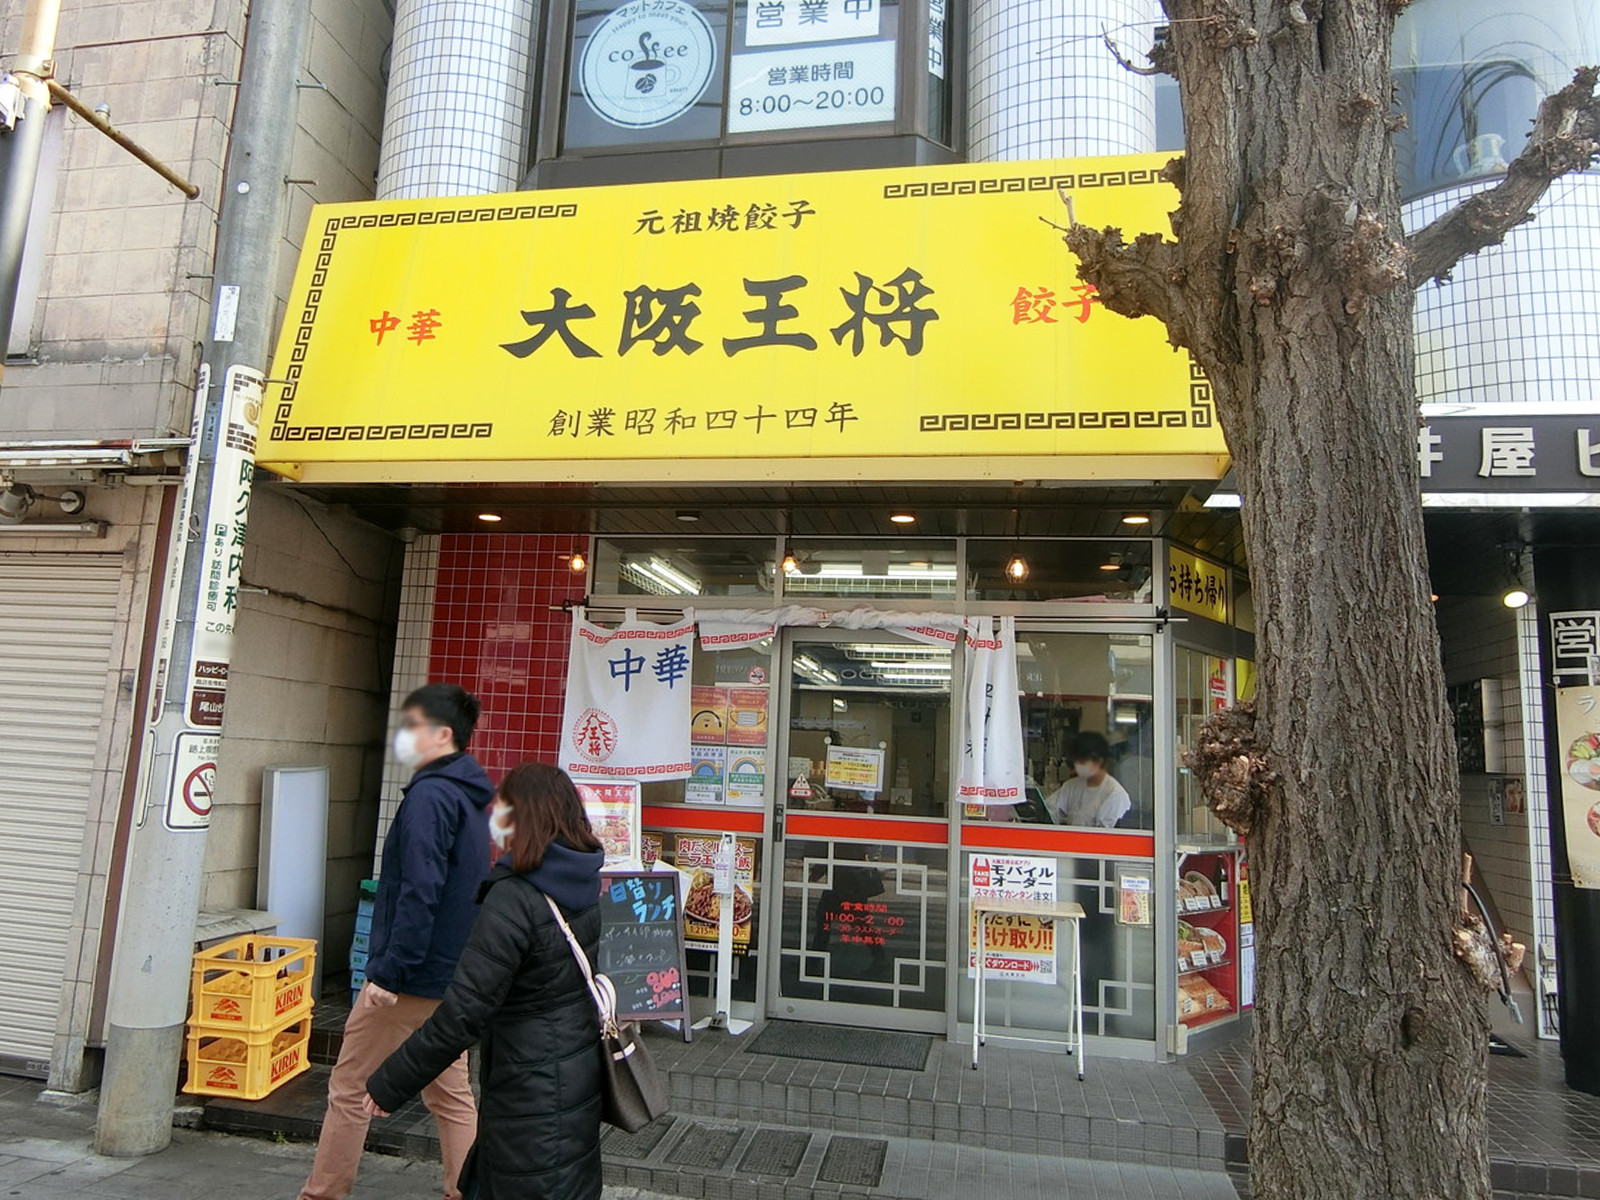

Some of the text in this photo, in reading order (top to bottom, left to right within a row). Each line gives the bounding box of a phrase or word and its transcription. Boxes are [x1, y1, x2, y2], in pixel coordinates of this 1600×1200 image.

[767, 60, 854, 86] 営業時間
[633, 199, 817, 235] 元祖焼餃子
[498, 266, 940, 359] 大阪王将
[1010, 283, 1100, 325] 餃子
[369, 308, 442, 347] 中華
[547, 401, 860, 438] 創業昭和四十四年
[608, 644, 690, 692] 中華
[991, 865, 1054, 878] モバイル
[991, 877, 1053, 888] オーダー
[275, 983, 305, 1010] KIRIN
[271, 1047, 300, 1078] KIRIN
